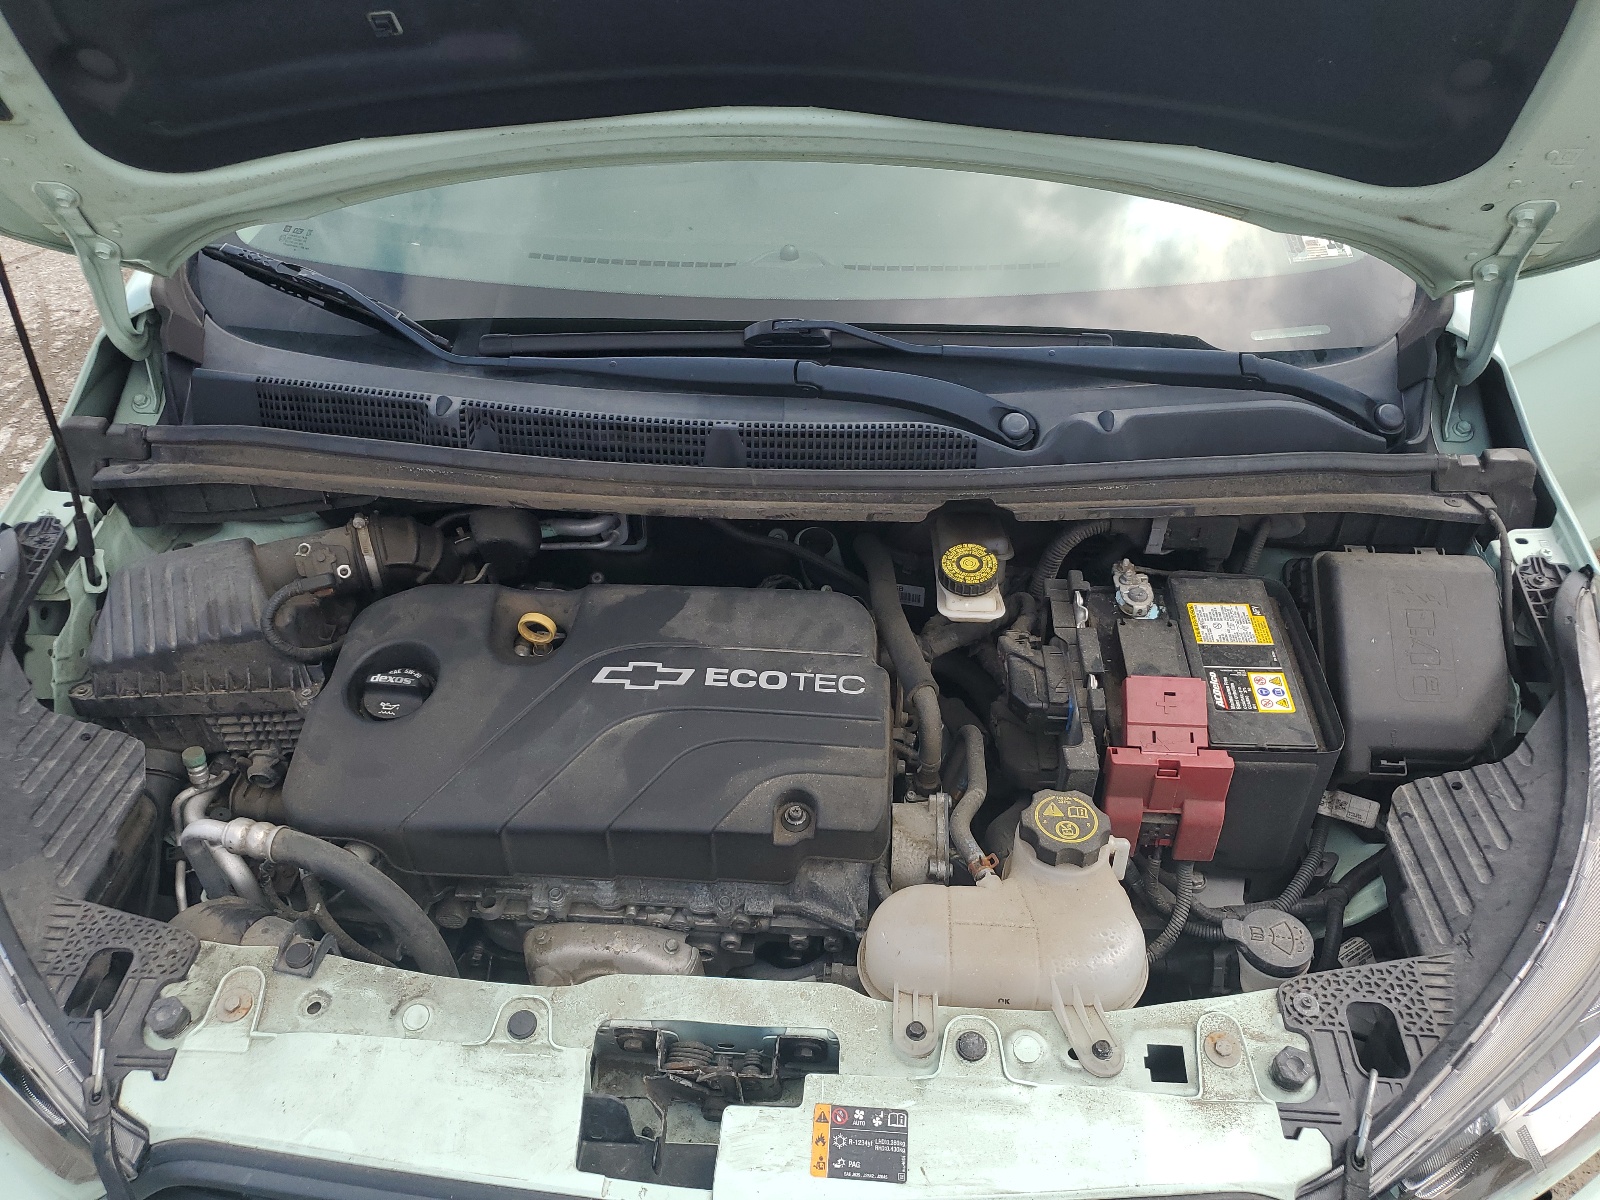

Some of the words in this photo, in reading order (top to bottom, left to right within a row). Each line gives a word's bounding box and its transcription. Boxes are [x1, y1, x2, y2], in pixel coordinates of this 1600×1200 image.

[370, 674, 412, 684] dexos
[704, 667, 866, 695] ECOTEC
[848, 1139, 873, 1147] R-1234yf
